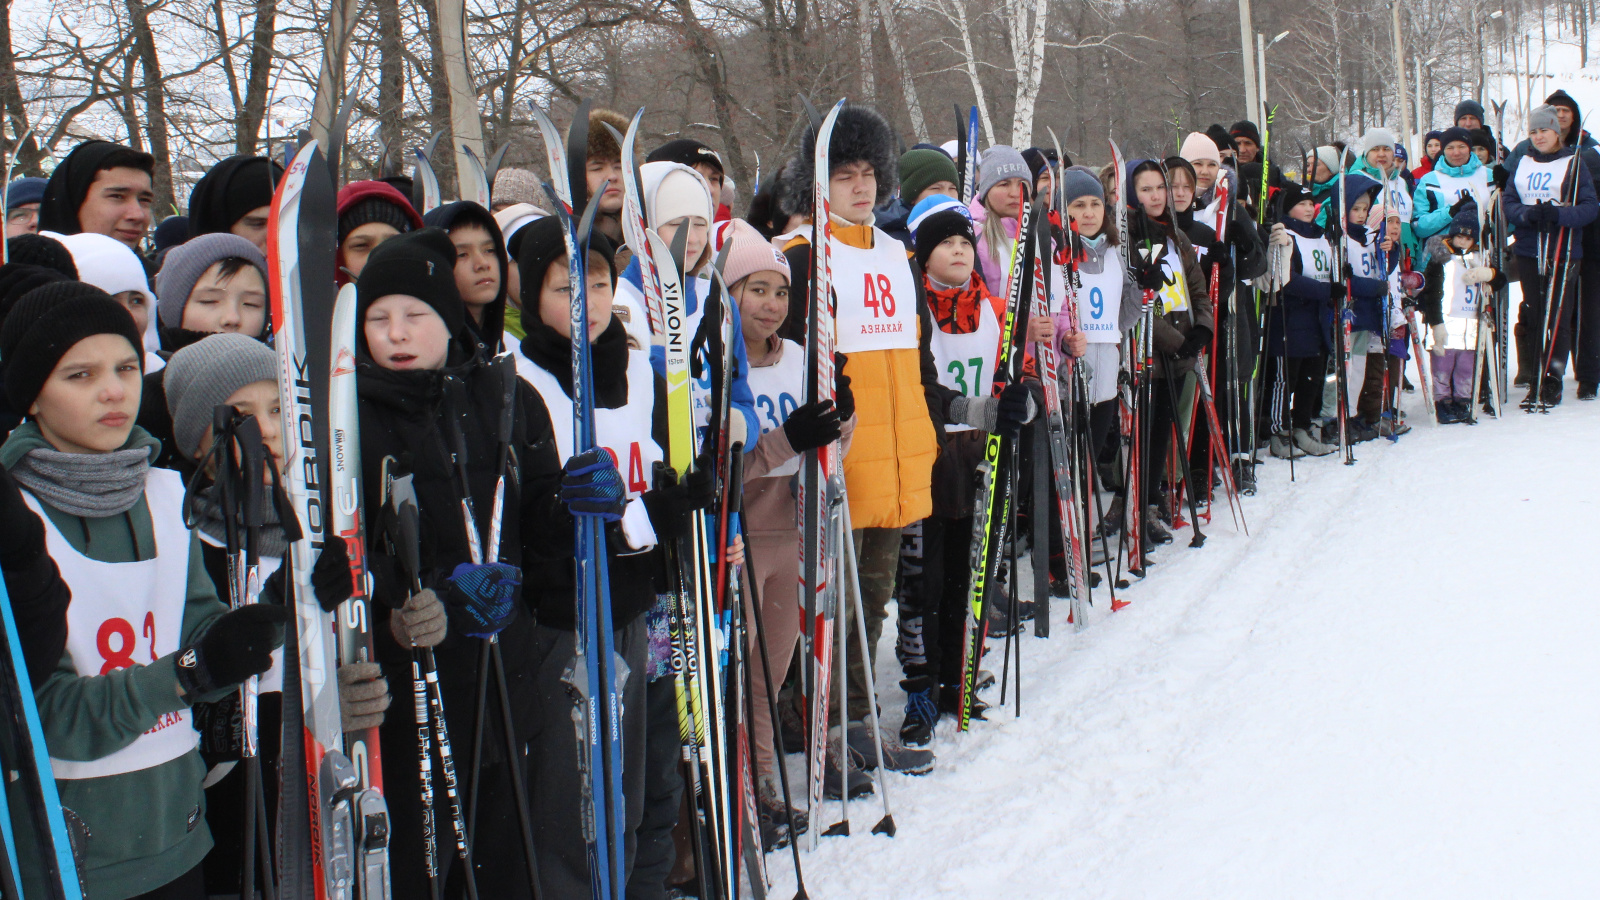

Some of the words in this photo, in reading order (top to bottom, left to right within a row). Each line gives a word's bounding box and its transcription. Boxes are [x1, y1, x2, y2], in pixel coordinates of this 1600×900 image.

[962, 149, 976, 205] RDWAY
[1527, 172, 1552, 191] 102
[1120, 210, 1128, 259] RDIK
[1312, 249, 1330, 272] 82
[1361, 252, 1377, 276] 54
[864, 273, 896, 318] 48
[1089, 287, 1104, 319] 9
[1464, 283, 1480, 304] 57
[664, 282, 683, 352] INOVIK
[861, 321, 903, 334] АЗНАКАЙ
[1000, 311, 1014, 363] SABLE
[1080, 321, 1113, 331] ЗНАКАЙ
[668, 358, 684, 366] 157cm
[947, 357, 983, 397] 37
[756, 392, 800, 434] 30
[1066, 529, 1078, 601] CLASSIC
[465, 604, 488, 626] SPORT
[589, 695, 598, 745] ROSSIGNOL
[611, 692, 619, 742] ROSSIGNOL
[308, 774, 322, 868] NORDIK
